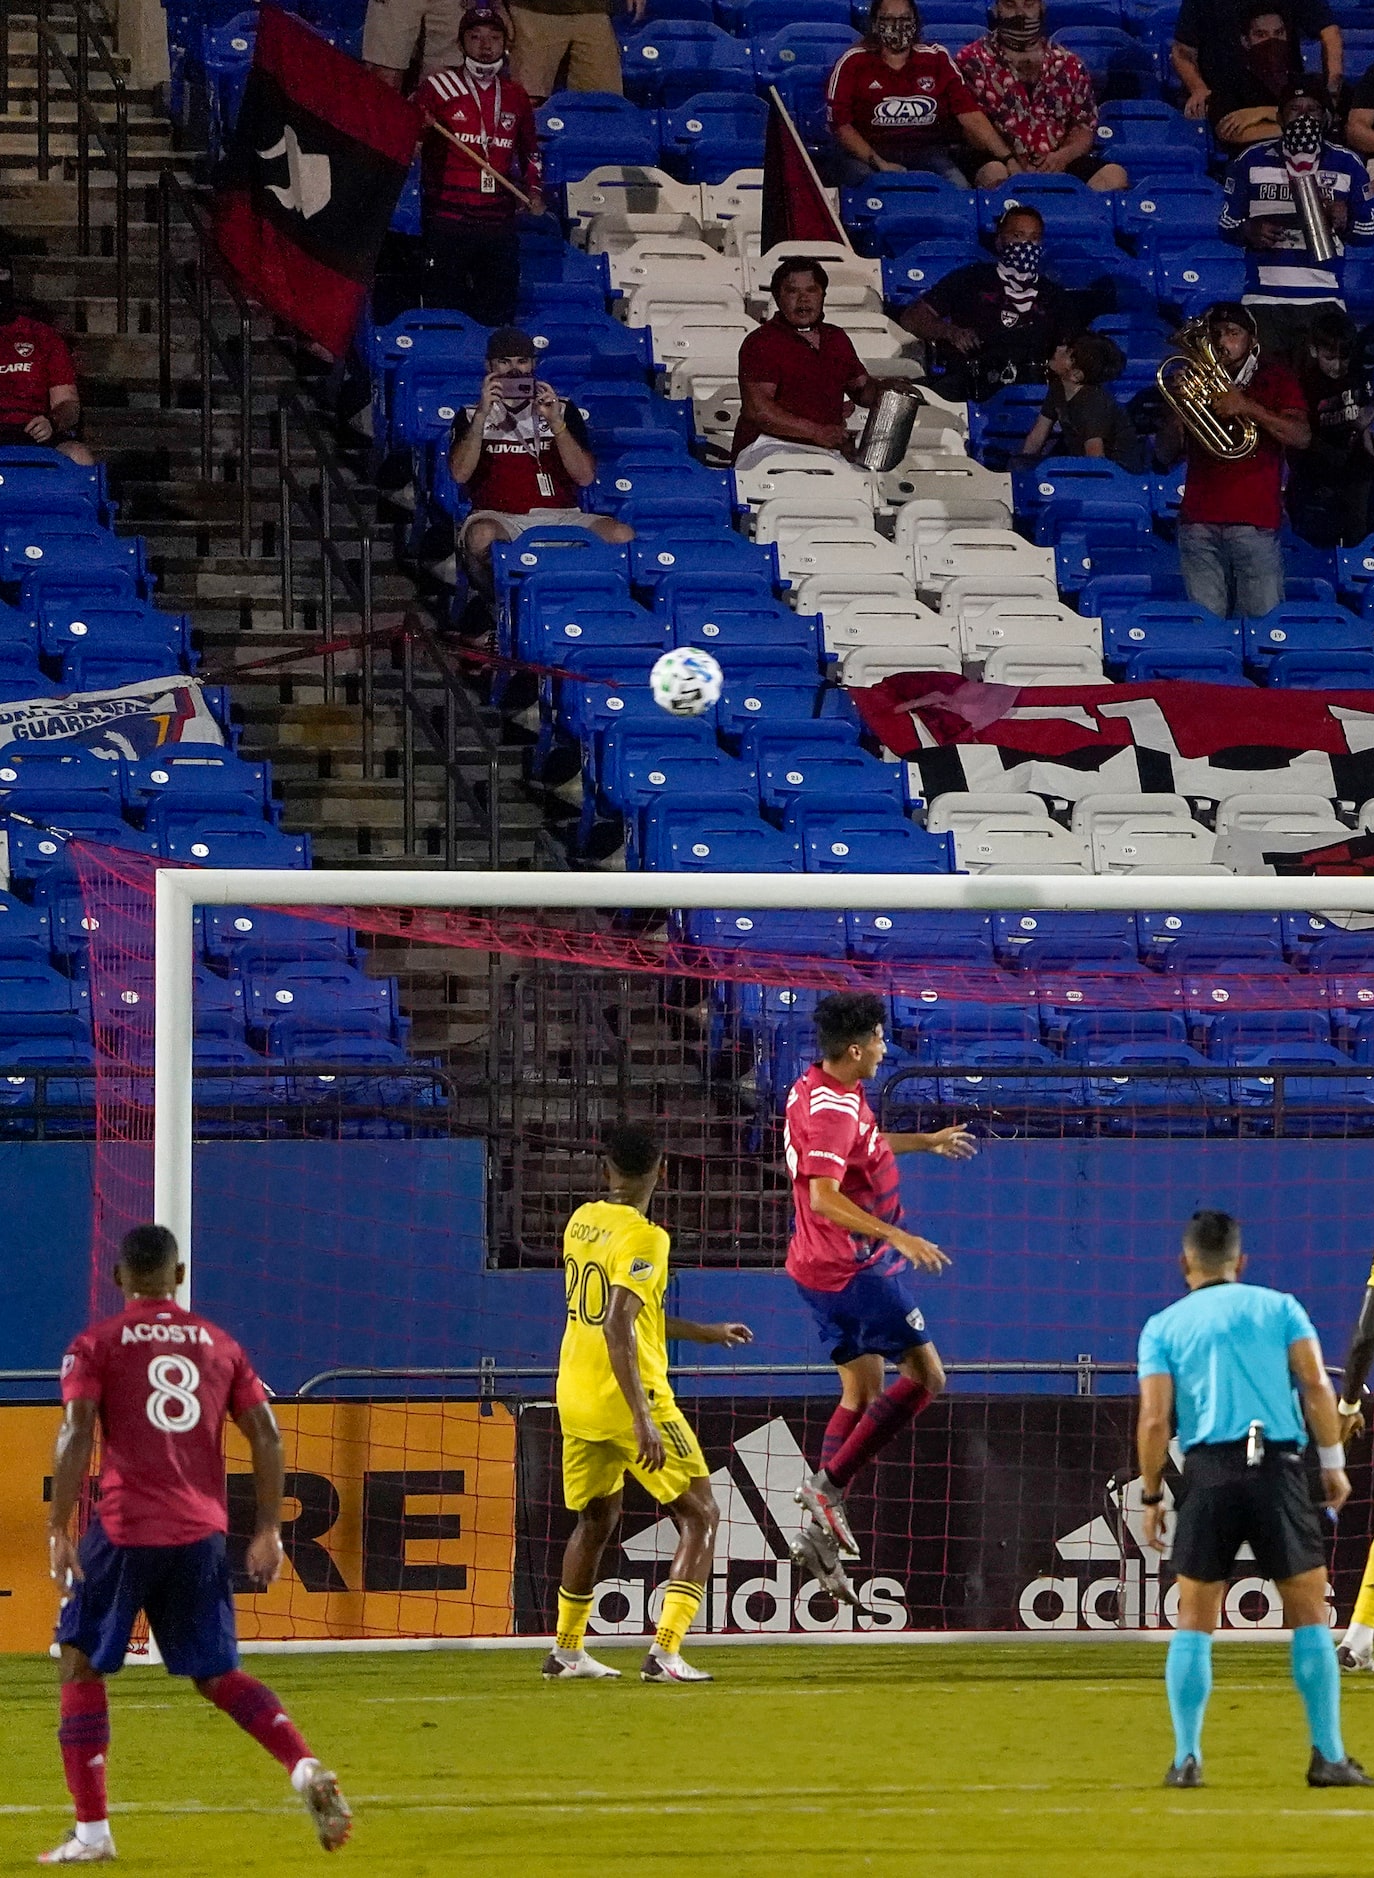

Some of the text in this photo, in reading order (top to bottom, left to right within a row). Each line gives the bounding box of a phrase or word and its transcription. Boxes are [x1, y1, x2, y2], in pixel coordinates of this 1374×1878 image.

[1259, 183, 1277, 200] FC
[121, 1324, 214, 1346] ACOSTA
[146, 1353, 201, 1433] 8
[1019, 1558, 1338, 1630] adia
